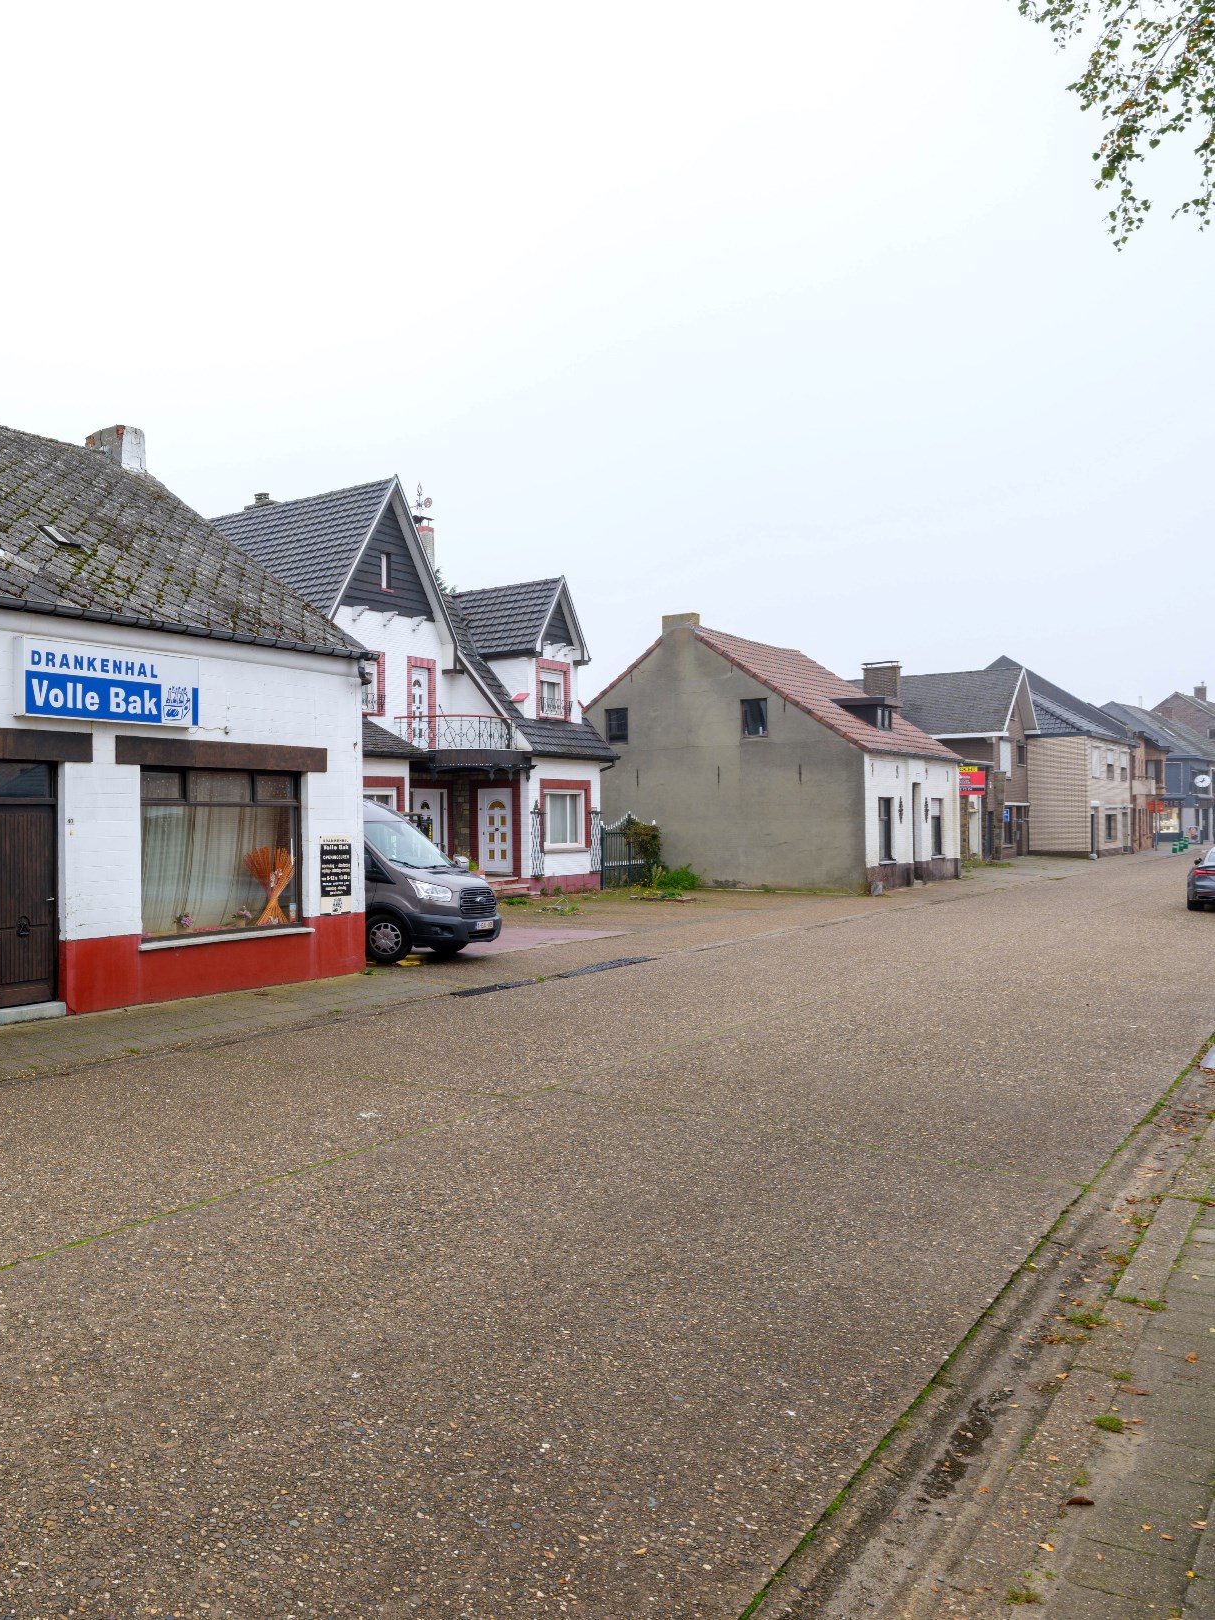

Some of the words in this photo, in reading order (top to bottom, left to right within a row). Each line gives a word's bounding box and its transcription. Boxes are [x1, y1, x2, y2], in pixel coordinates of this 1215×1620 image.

[31, 650, 158, 678] DRANKENHAL
[32, 679, 100, 711] Volle
[109, 687, 158, 714] Bak
